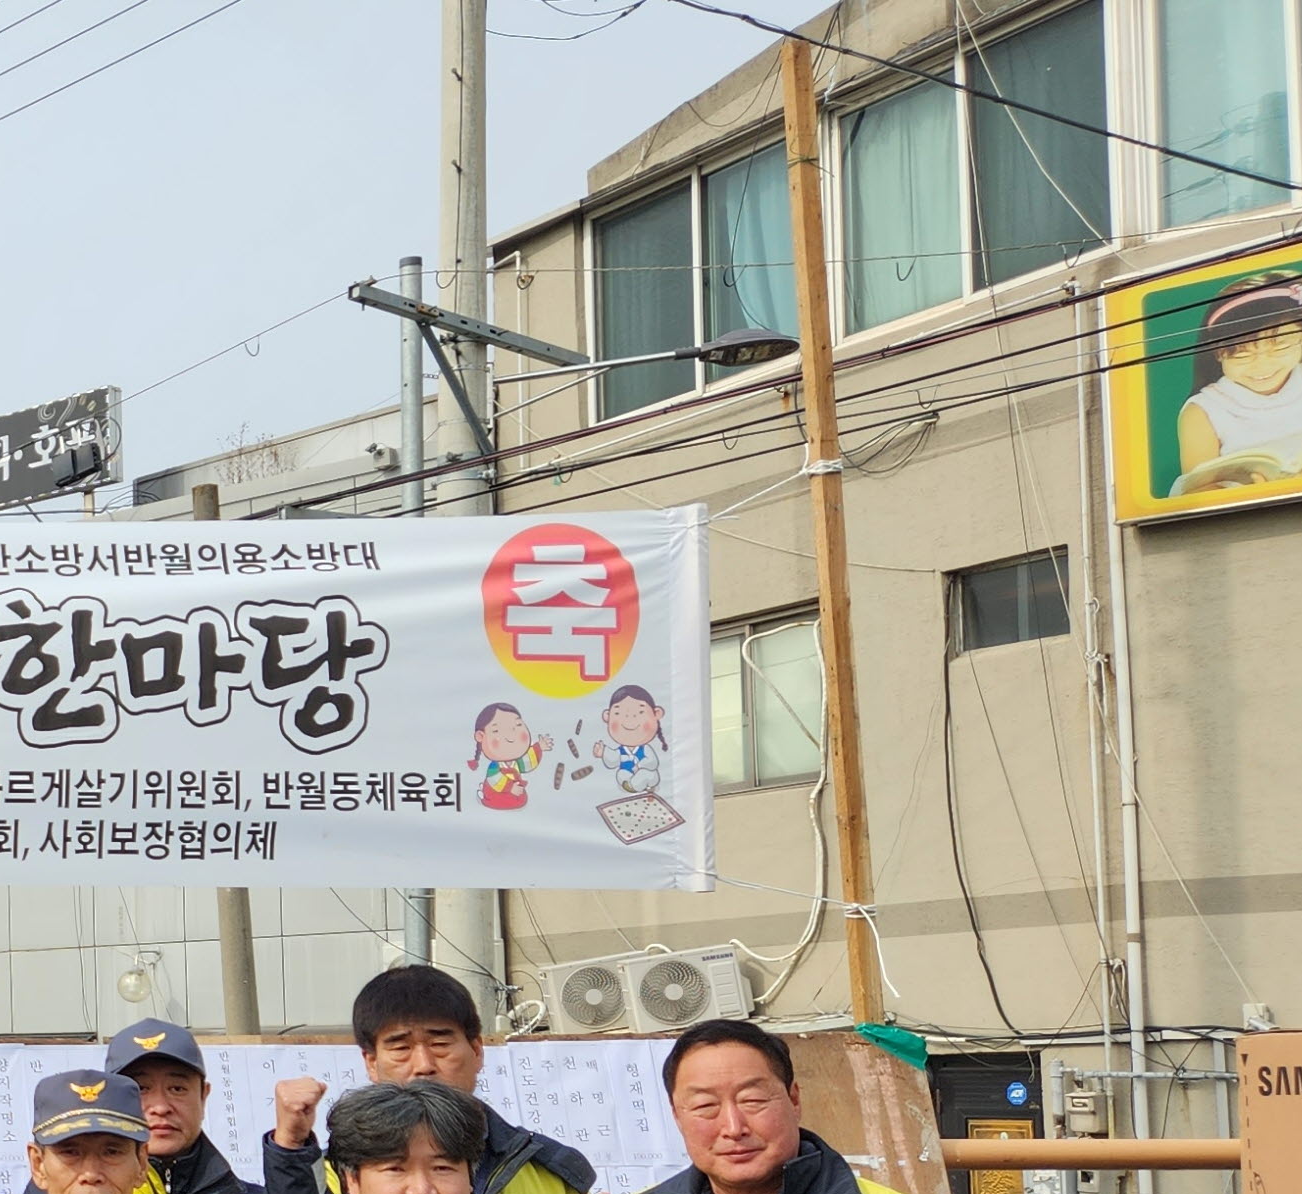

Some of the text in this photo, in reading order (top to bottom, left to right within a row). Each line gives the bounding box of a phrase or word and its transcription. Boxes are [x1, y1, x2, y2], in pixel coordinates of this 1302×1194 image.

[502, 543, 621, 682] 축
[263, 771, 461, 812] 반월동체육회
[39, 819, 277, 860] 사회보장협의체
